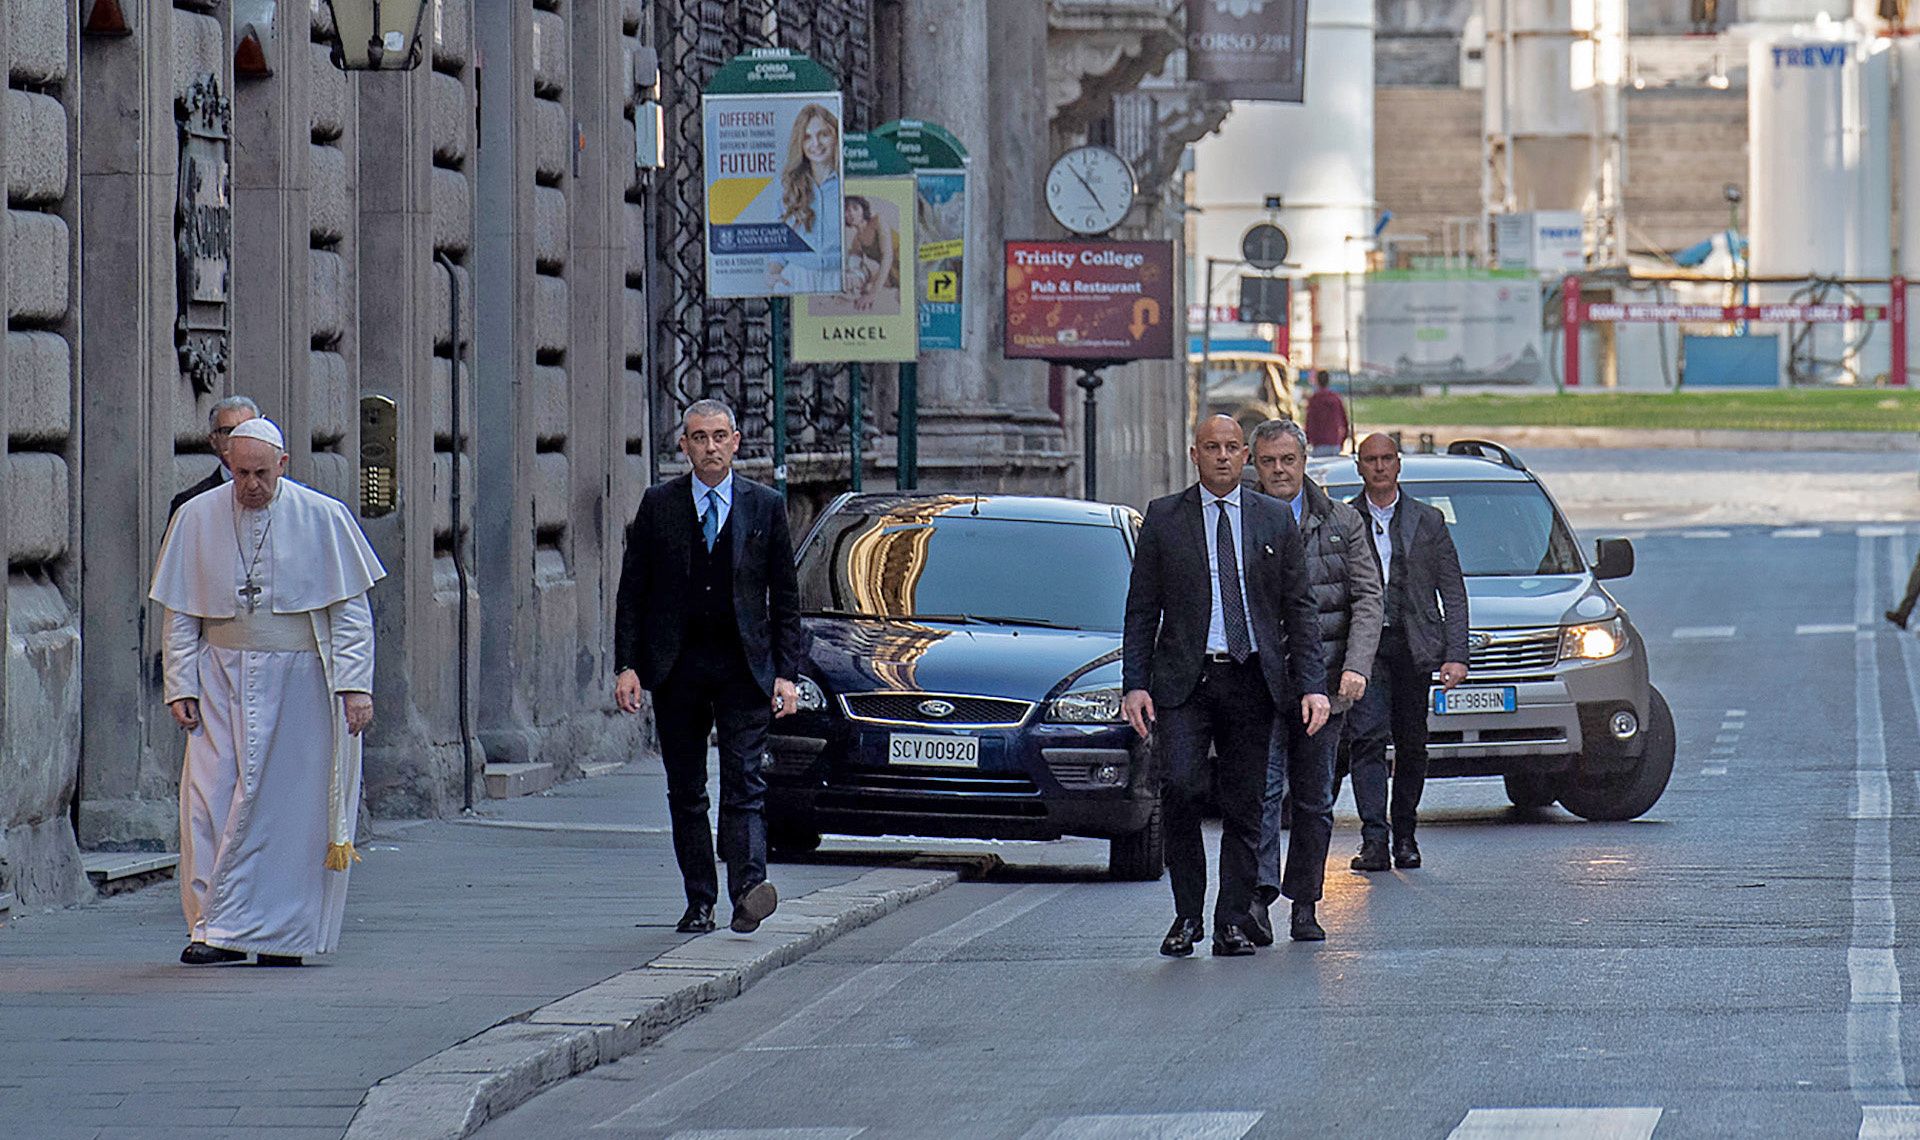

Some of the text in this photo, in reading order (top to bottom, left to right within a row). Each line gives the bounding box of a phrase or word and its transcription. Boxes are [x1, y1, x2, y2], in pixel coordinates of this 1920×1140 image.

[1188, 33, 1257, 51] CORSO
[1772, 45, 1846, 67] TREVI
[720, 111, 775, 127] DIFFERENT
[720, 152, 776, 173] FUTURE
[1014, 250, 1144, 269] Trinity College
[1031, 280, 1142, 294] Pub & Restaurant
[1589, 304, 1624, 320] ROMA
[823, 326, 887, 340] LANCEL
[1447, 693, 1504, 709] EF-985HN
[892, 740, 976, 761] SCV 00920
